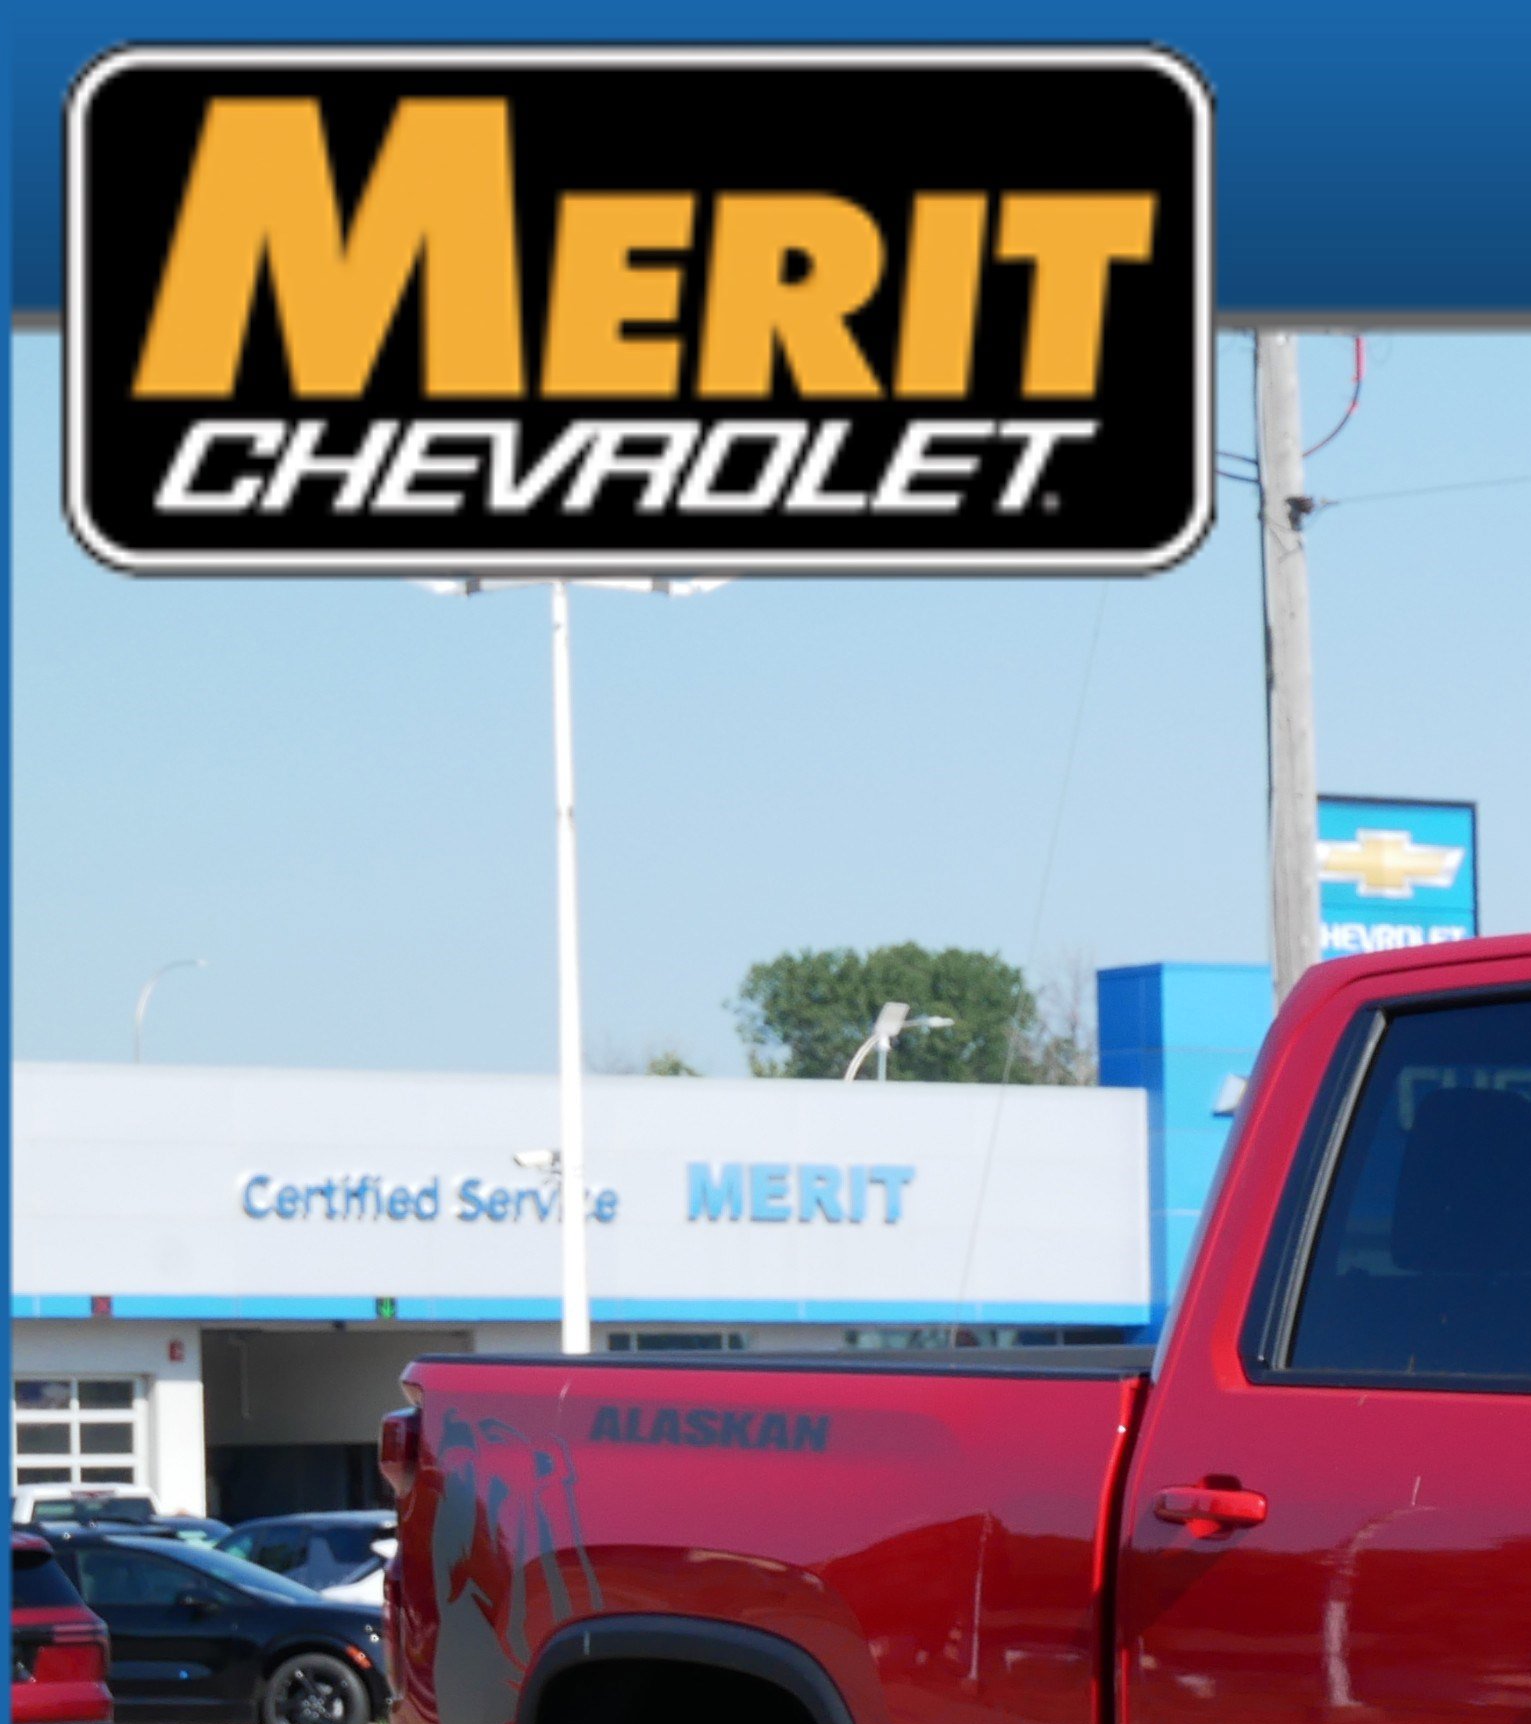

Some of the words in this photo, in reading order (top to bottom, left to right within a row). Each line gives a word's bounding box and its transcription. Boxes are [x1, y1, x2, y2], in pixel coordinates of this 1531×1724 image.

[1318, 920, 1467, 953] HEVROLET
[242, 1174, 439, 1222] Certified
[456, 1176, 620, 1224] Serve
[686, 1160, 916, 1226] MERIT
[588, 1404, 831, 1454] ALASKAN
